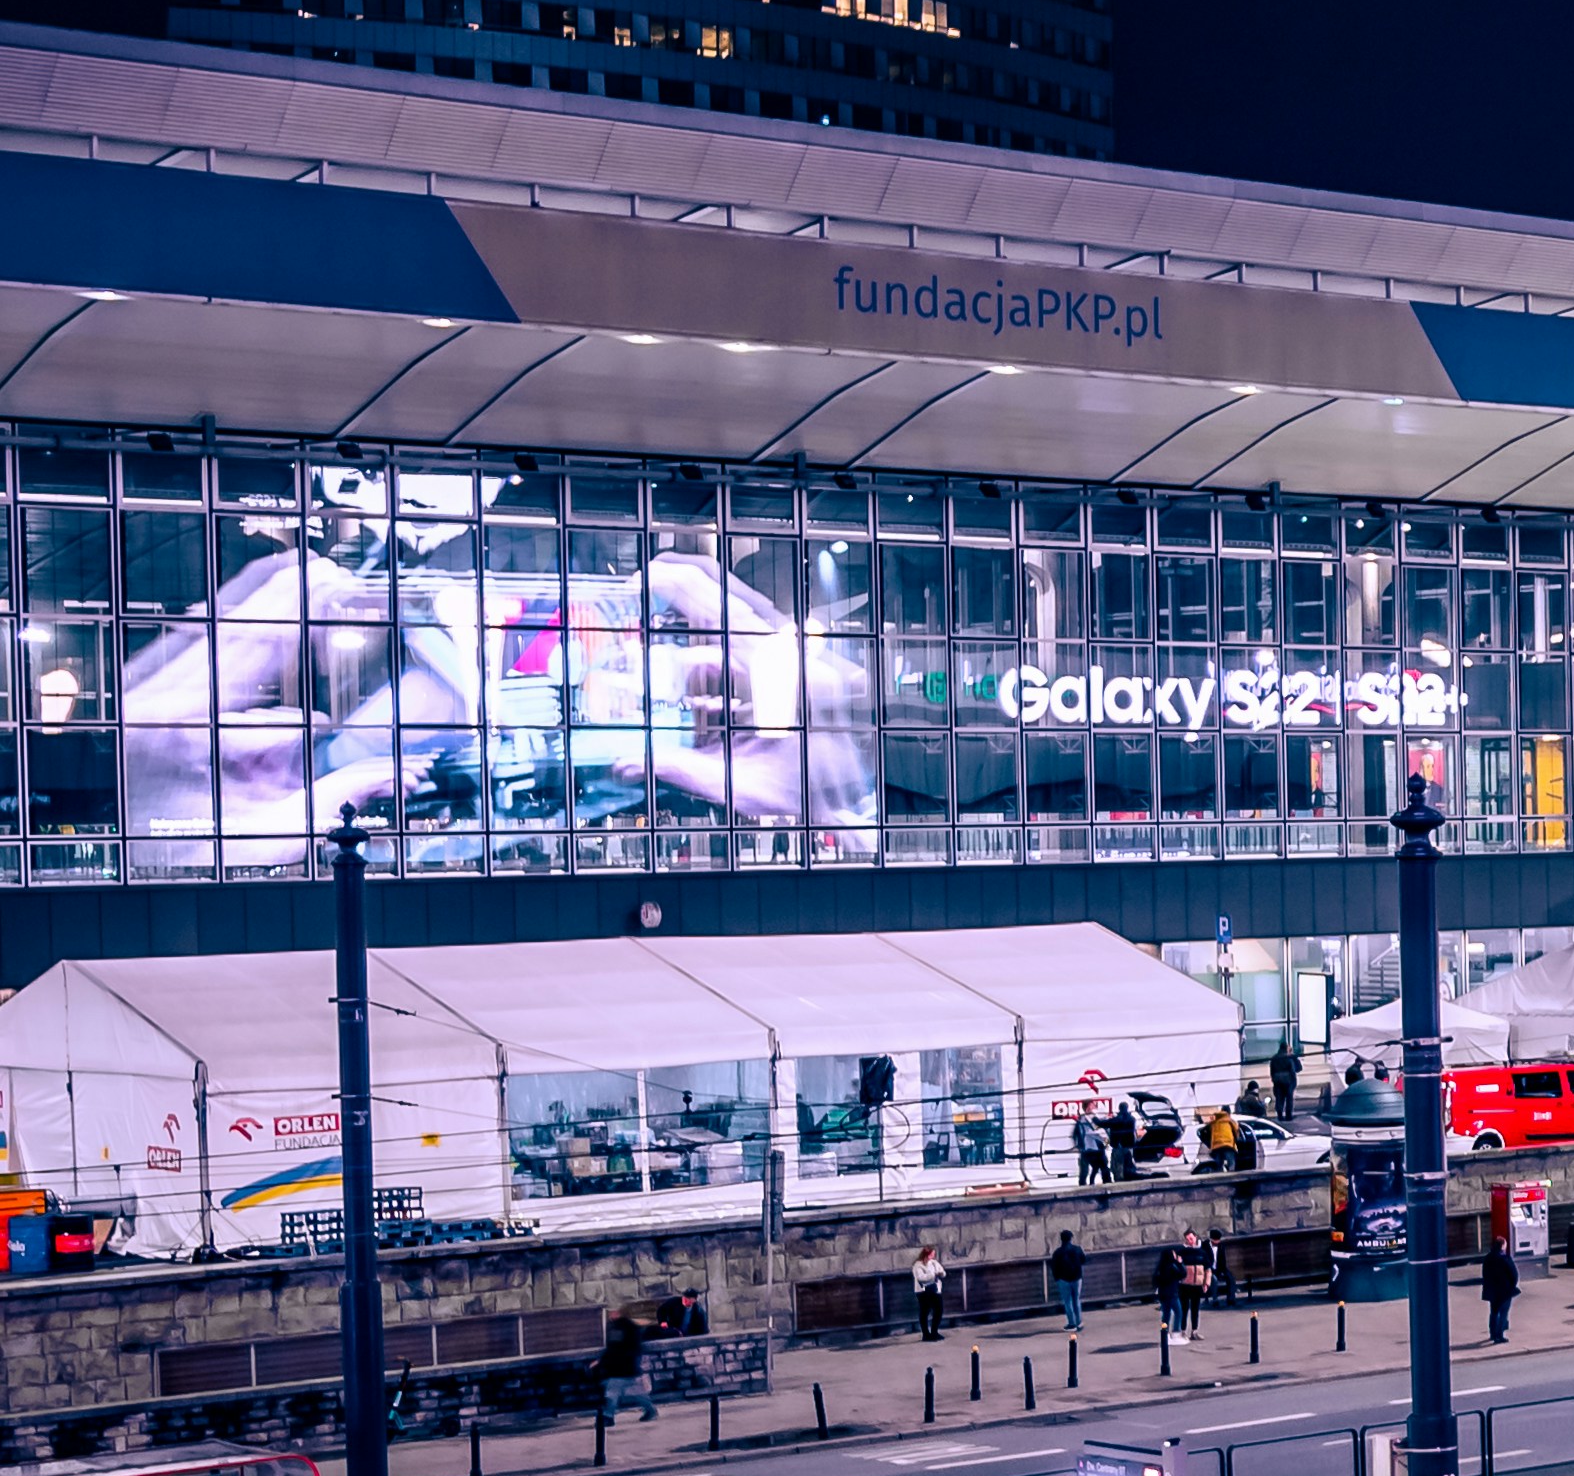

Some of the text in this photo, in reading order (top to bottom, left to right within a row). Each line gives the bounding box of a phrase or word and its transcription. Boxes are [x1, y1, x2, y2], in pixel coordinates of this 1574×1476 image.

[833, 265, 1163, 347] fundacjaPKP.pl
[998, 663, 1217, 730] Galaxy
[1219, 916, 1229, 936] P
[1054, 1099, 1110, 1117] ORLN
[277, 1115, 337, 1135] ORLEN
[275, 1134, 342, 1151] FUNDACJA
